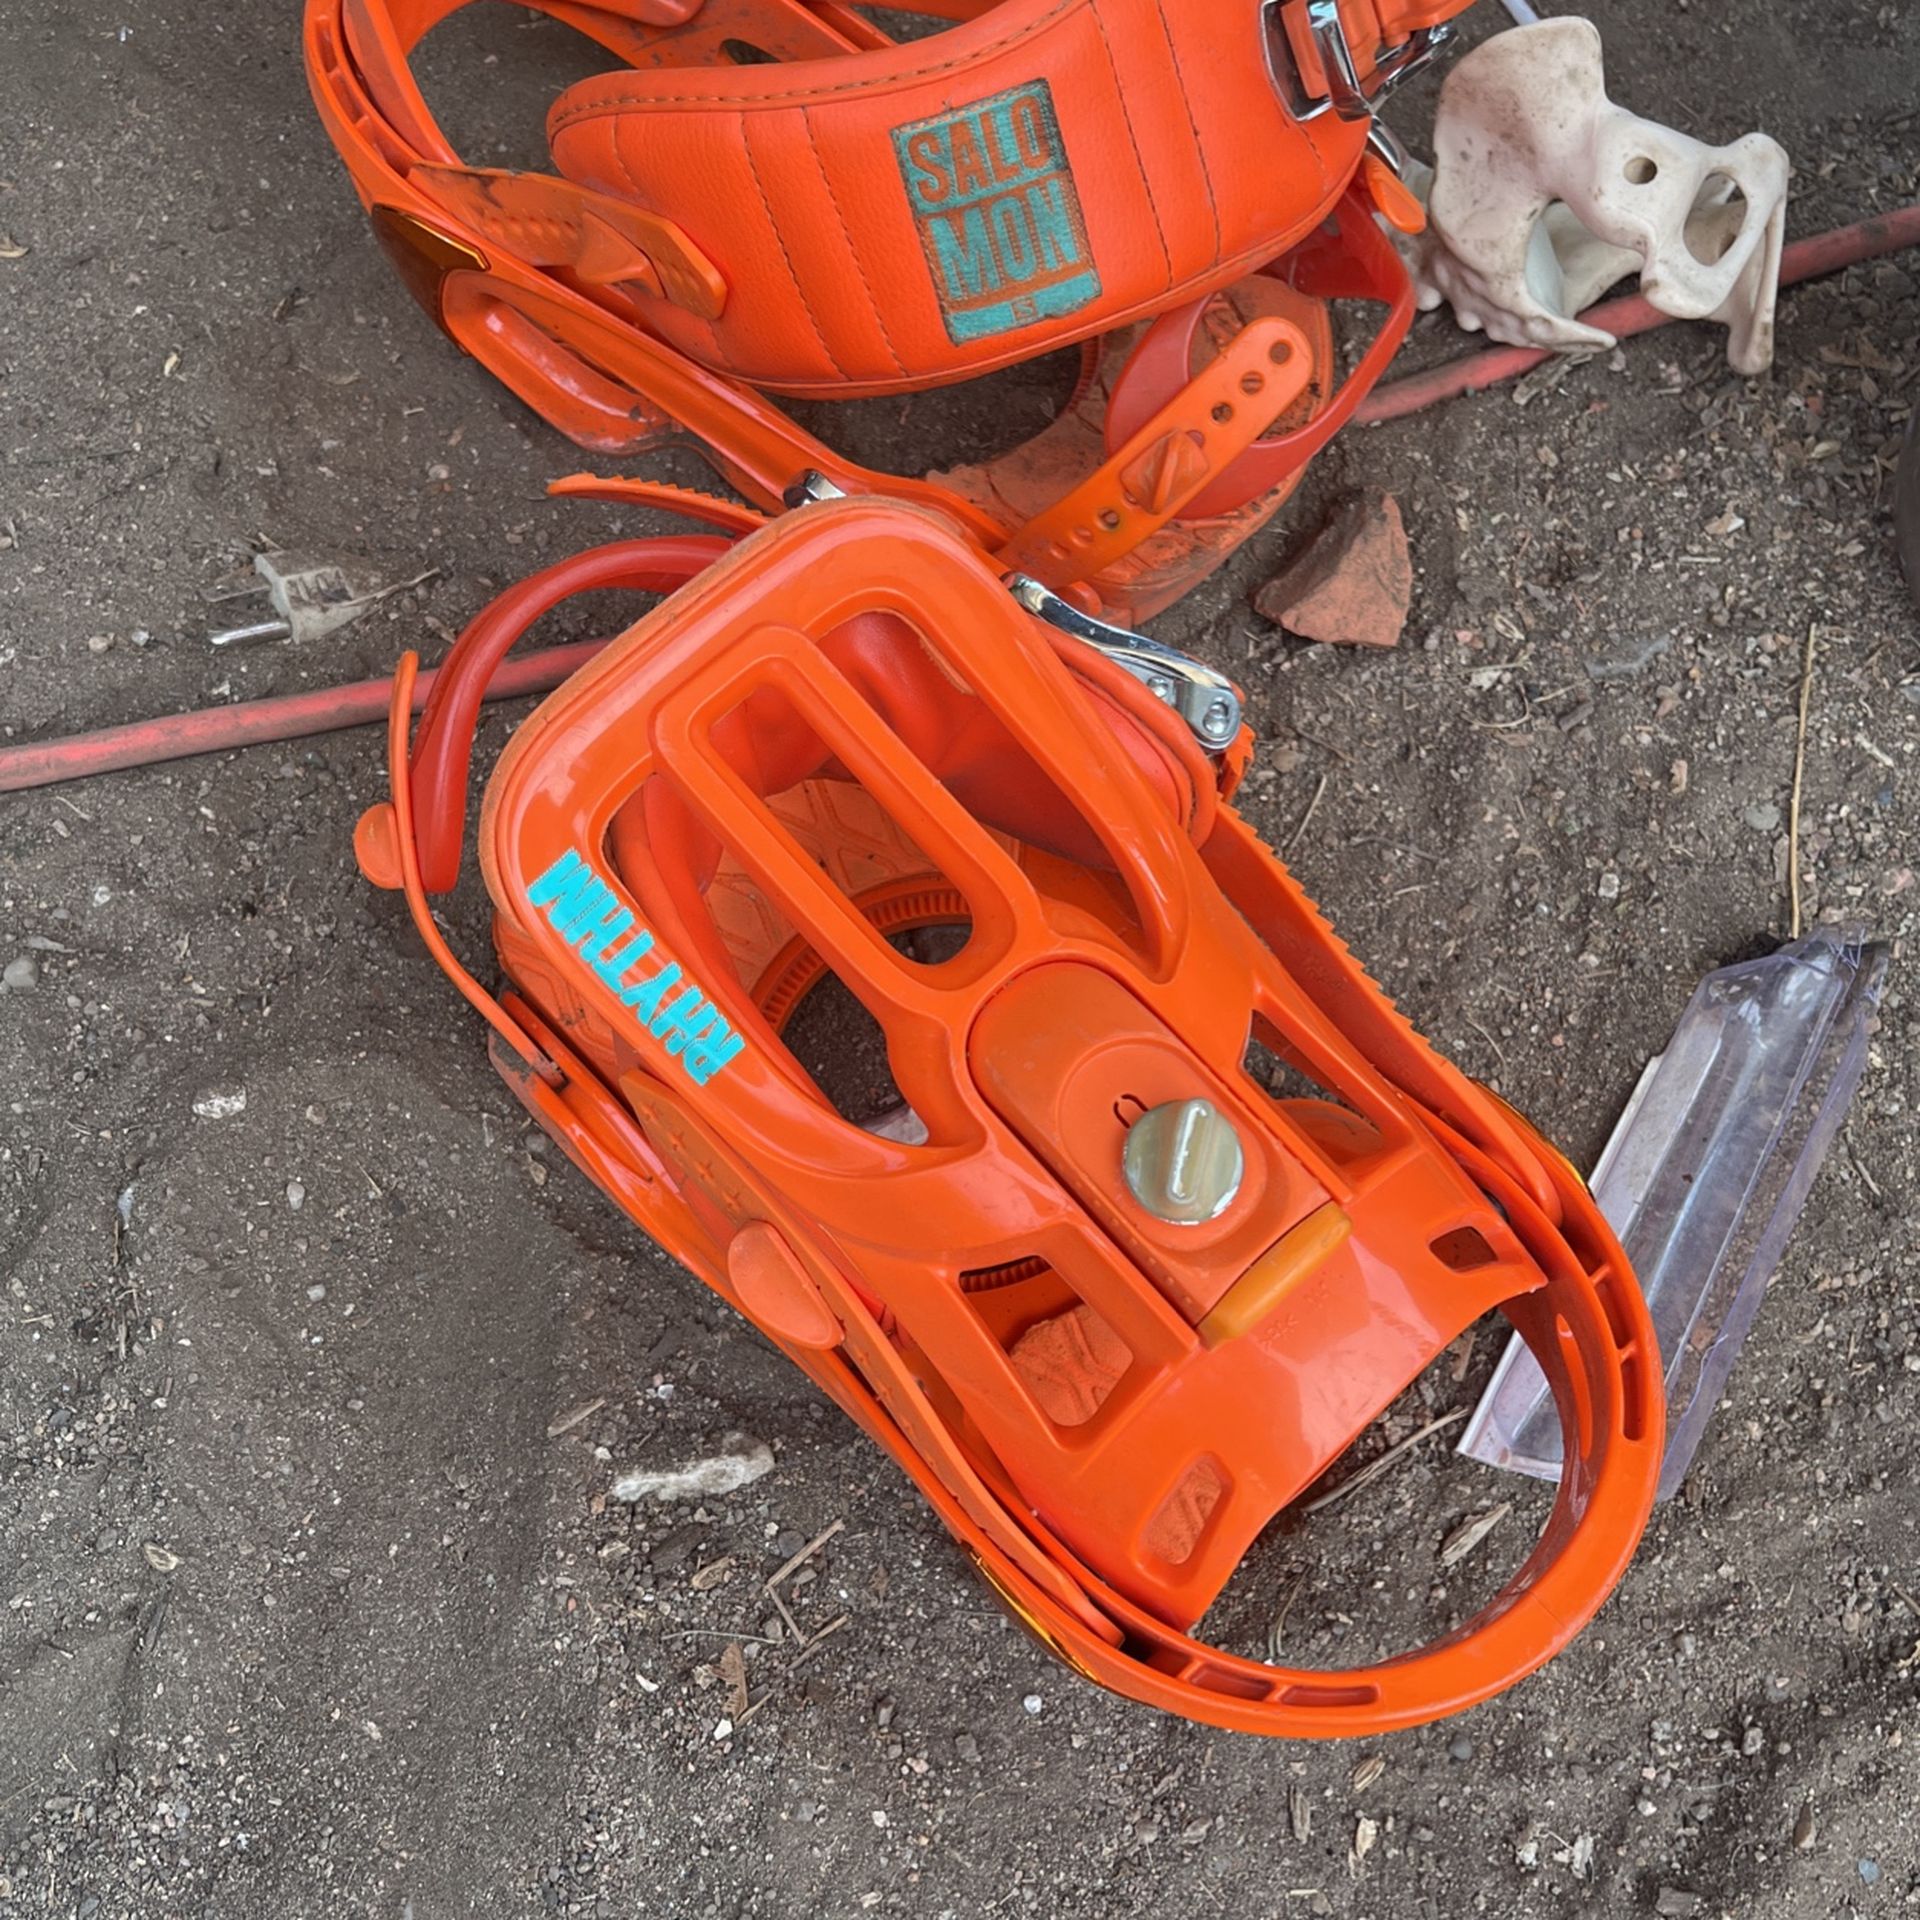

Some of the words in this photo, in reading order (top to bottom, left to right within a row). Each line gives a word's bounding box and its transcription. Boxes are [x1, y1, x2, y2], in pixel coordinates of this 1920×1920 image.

[907, 95, 1051, 202] SALO
[928, 179, 1080, 300] MON
[527, 846, 747, 1087] RHYTHM
